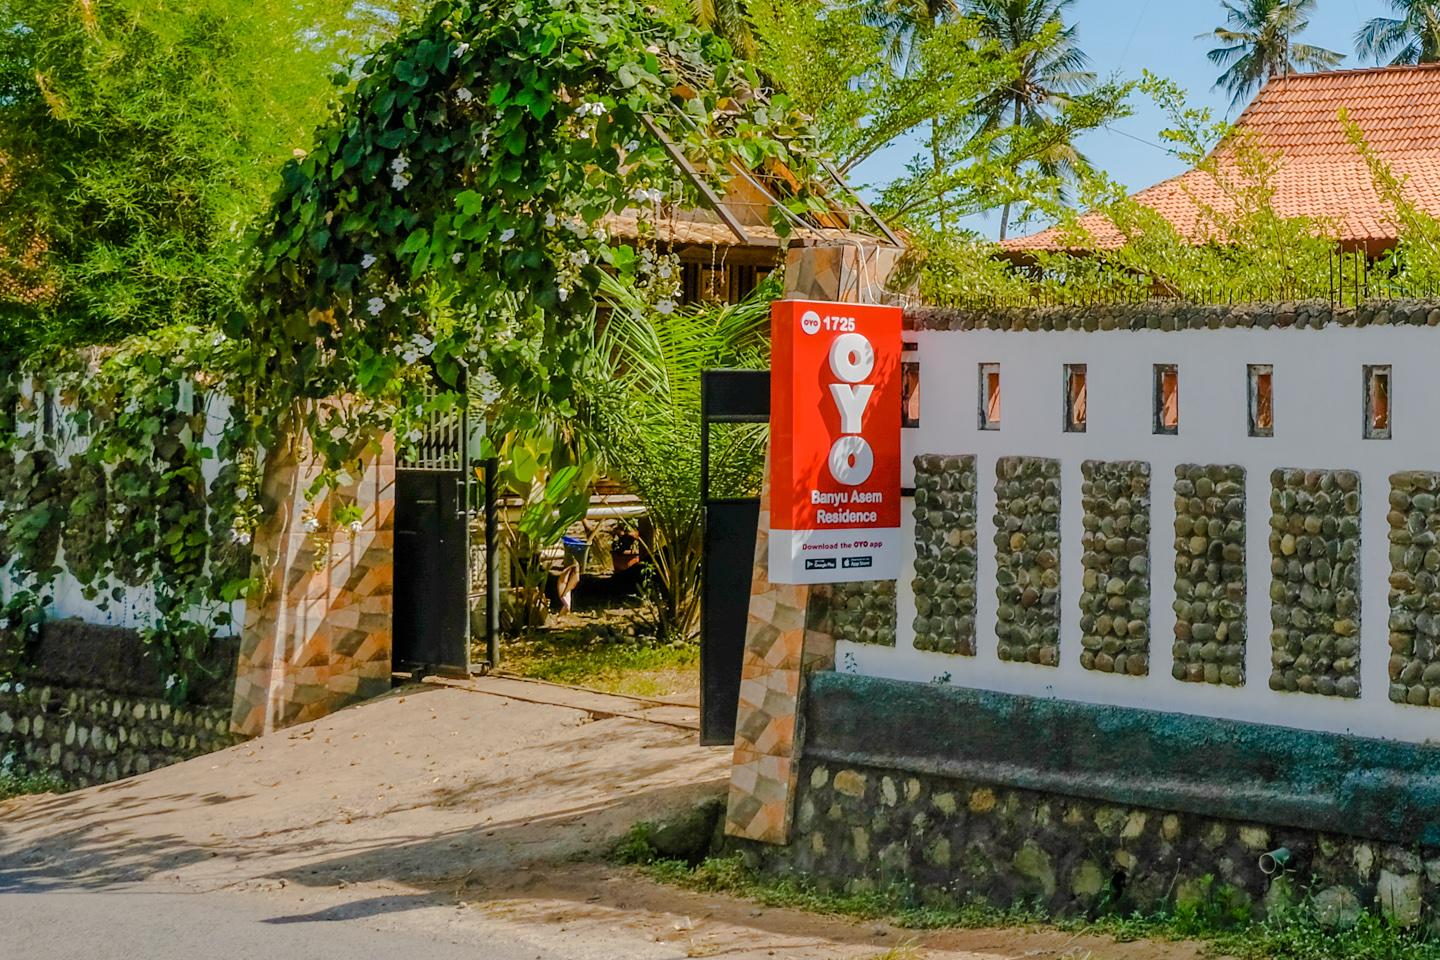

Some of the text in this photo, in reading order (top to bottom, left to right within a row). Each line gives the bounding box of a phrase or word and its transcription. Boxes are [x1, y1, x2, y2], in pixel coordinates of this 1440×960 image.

[804, 316, 856, 332] OYO 1725
[828, 333, 875, 486] OYO
[811, 489, 882, 507] Banyu Asem
[817, 508, 877, 524] Residence
[802, 542, 838, 550] Download
